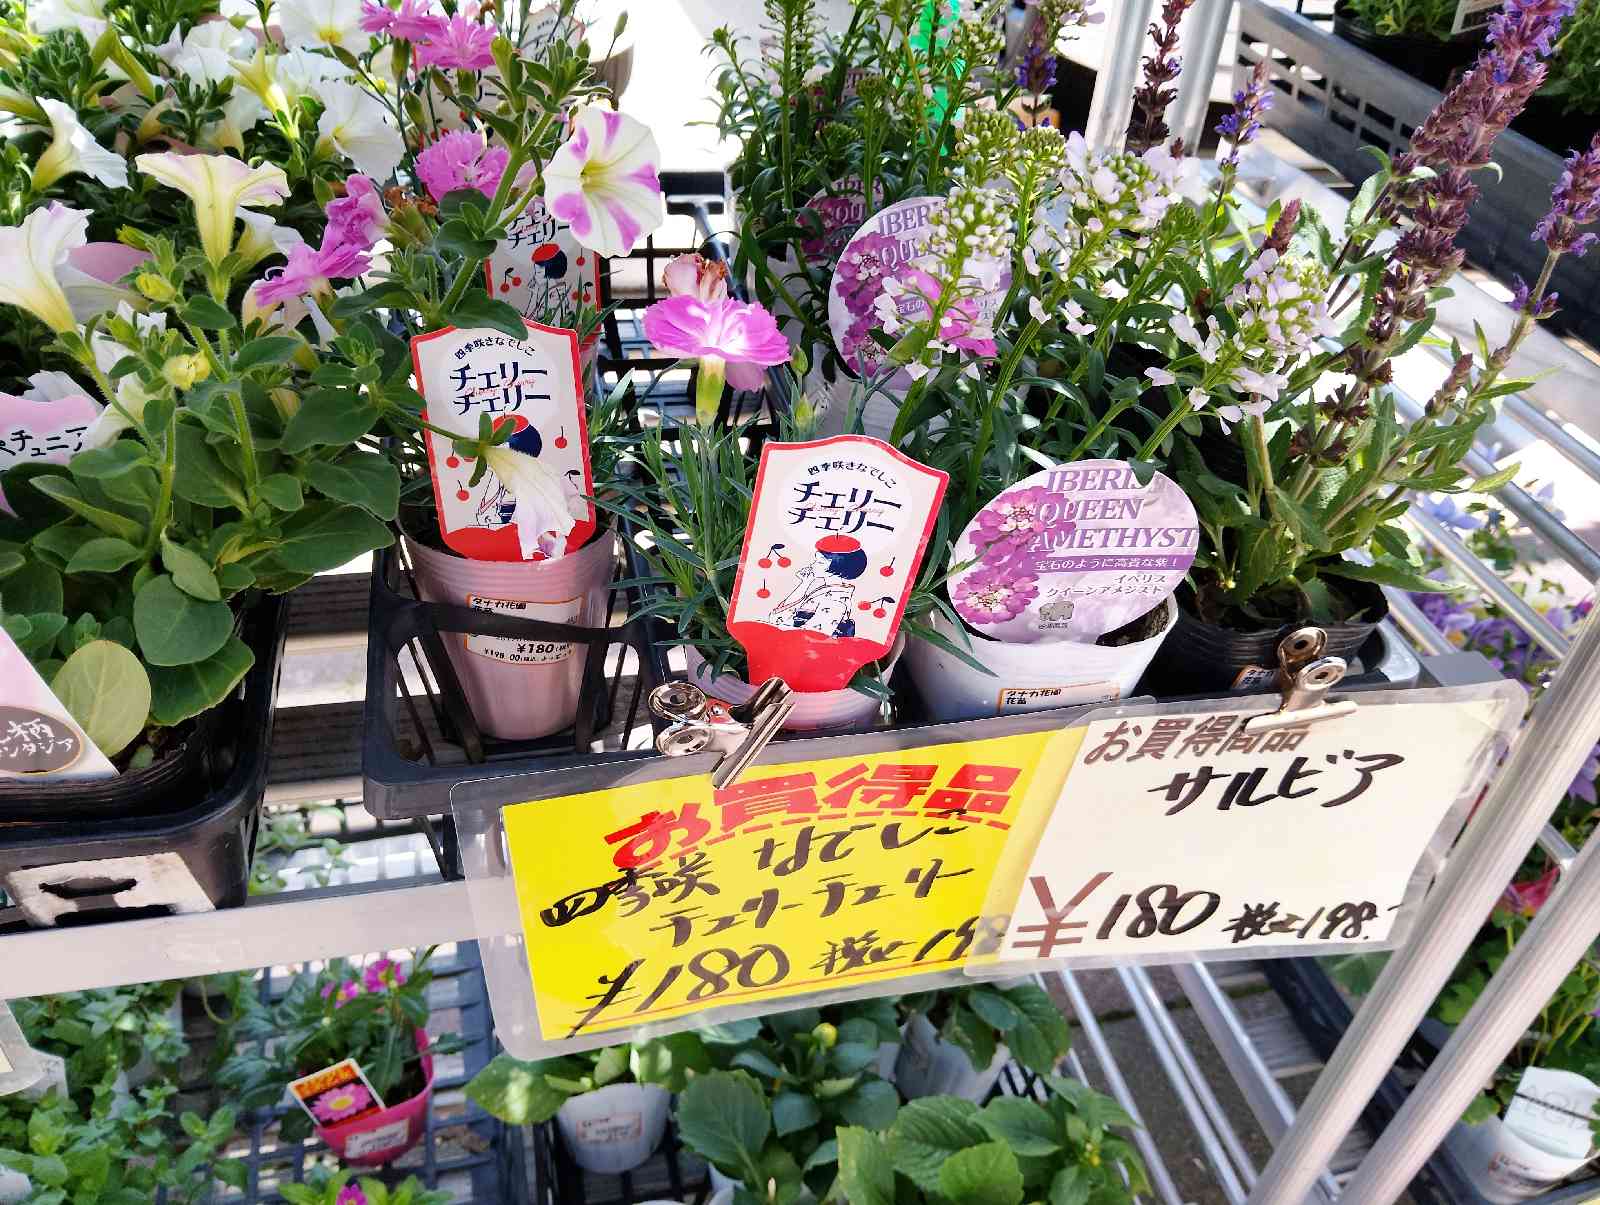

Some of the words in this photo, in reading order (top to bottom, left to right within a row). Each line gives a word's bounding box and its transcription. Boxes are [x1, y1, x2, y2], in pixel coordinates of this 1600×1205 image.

[450, 361, 548, 392] チェリー
[453, 385, 551, 415] チェリー
[793, 481, 902, 510] チェリー
[788, 507, 895, 534] チェリー
[1038, 498, 1145, 528] QUEEN
[1027, 527, 1200, 553] AMETHYST
[516, 643, 555, 654] ¥180
[1147, 749, 1405, 816] サルビア
[603, 762, 1023, 870] お買得品
[753, 808, 969, 877] なでしこ
[1011, 871, 1221, 958] ¥180
[564, 942, 791, 1040] ¥180
